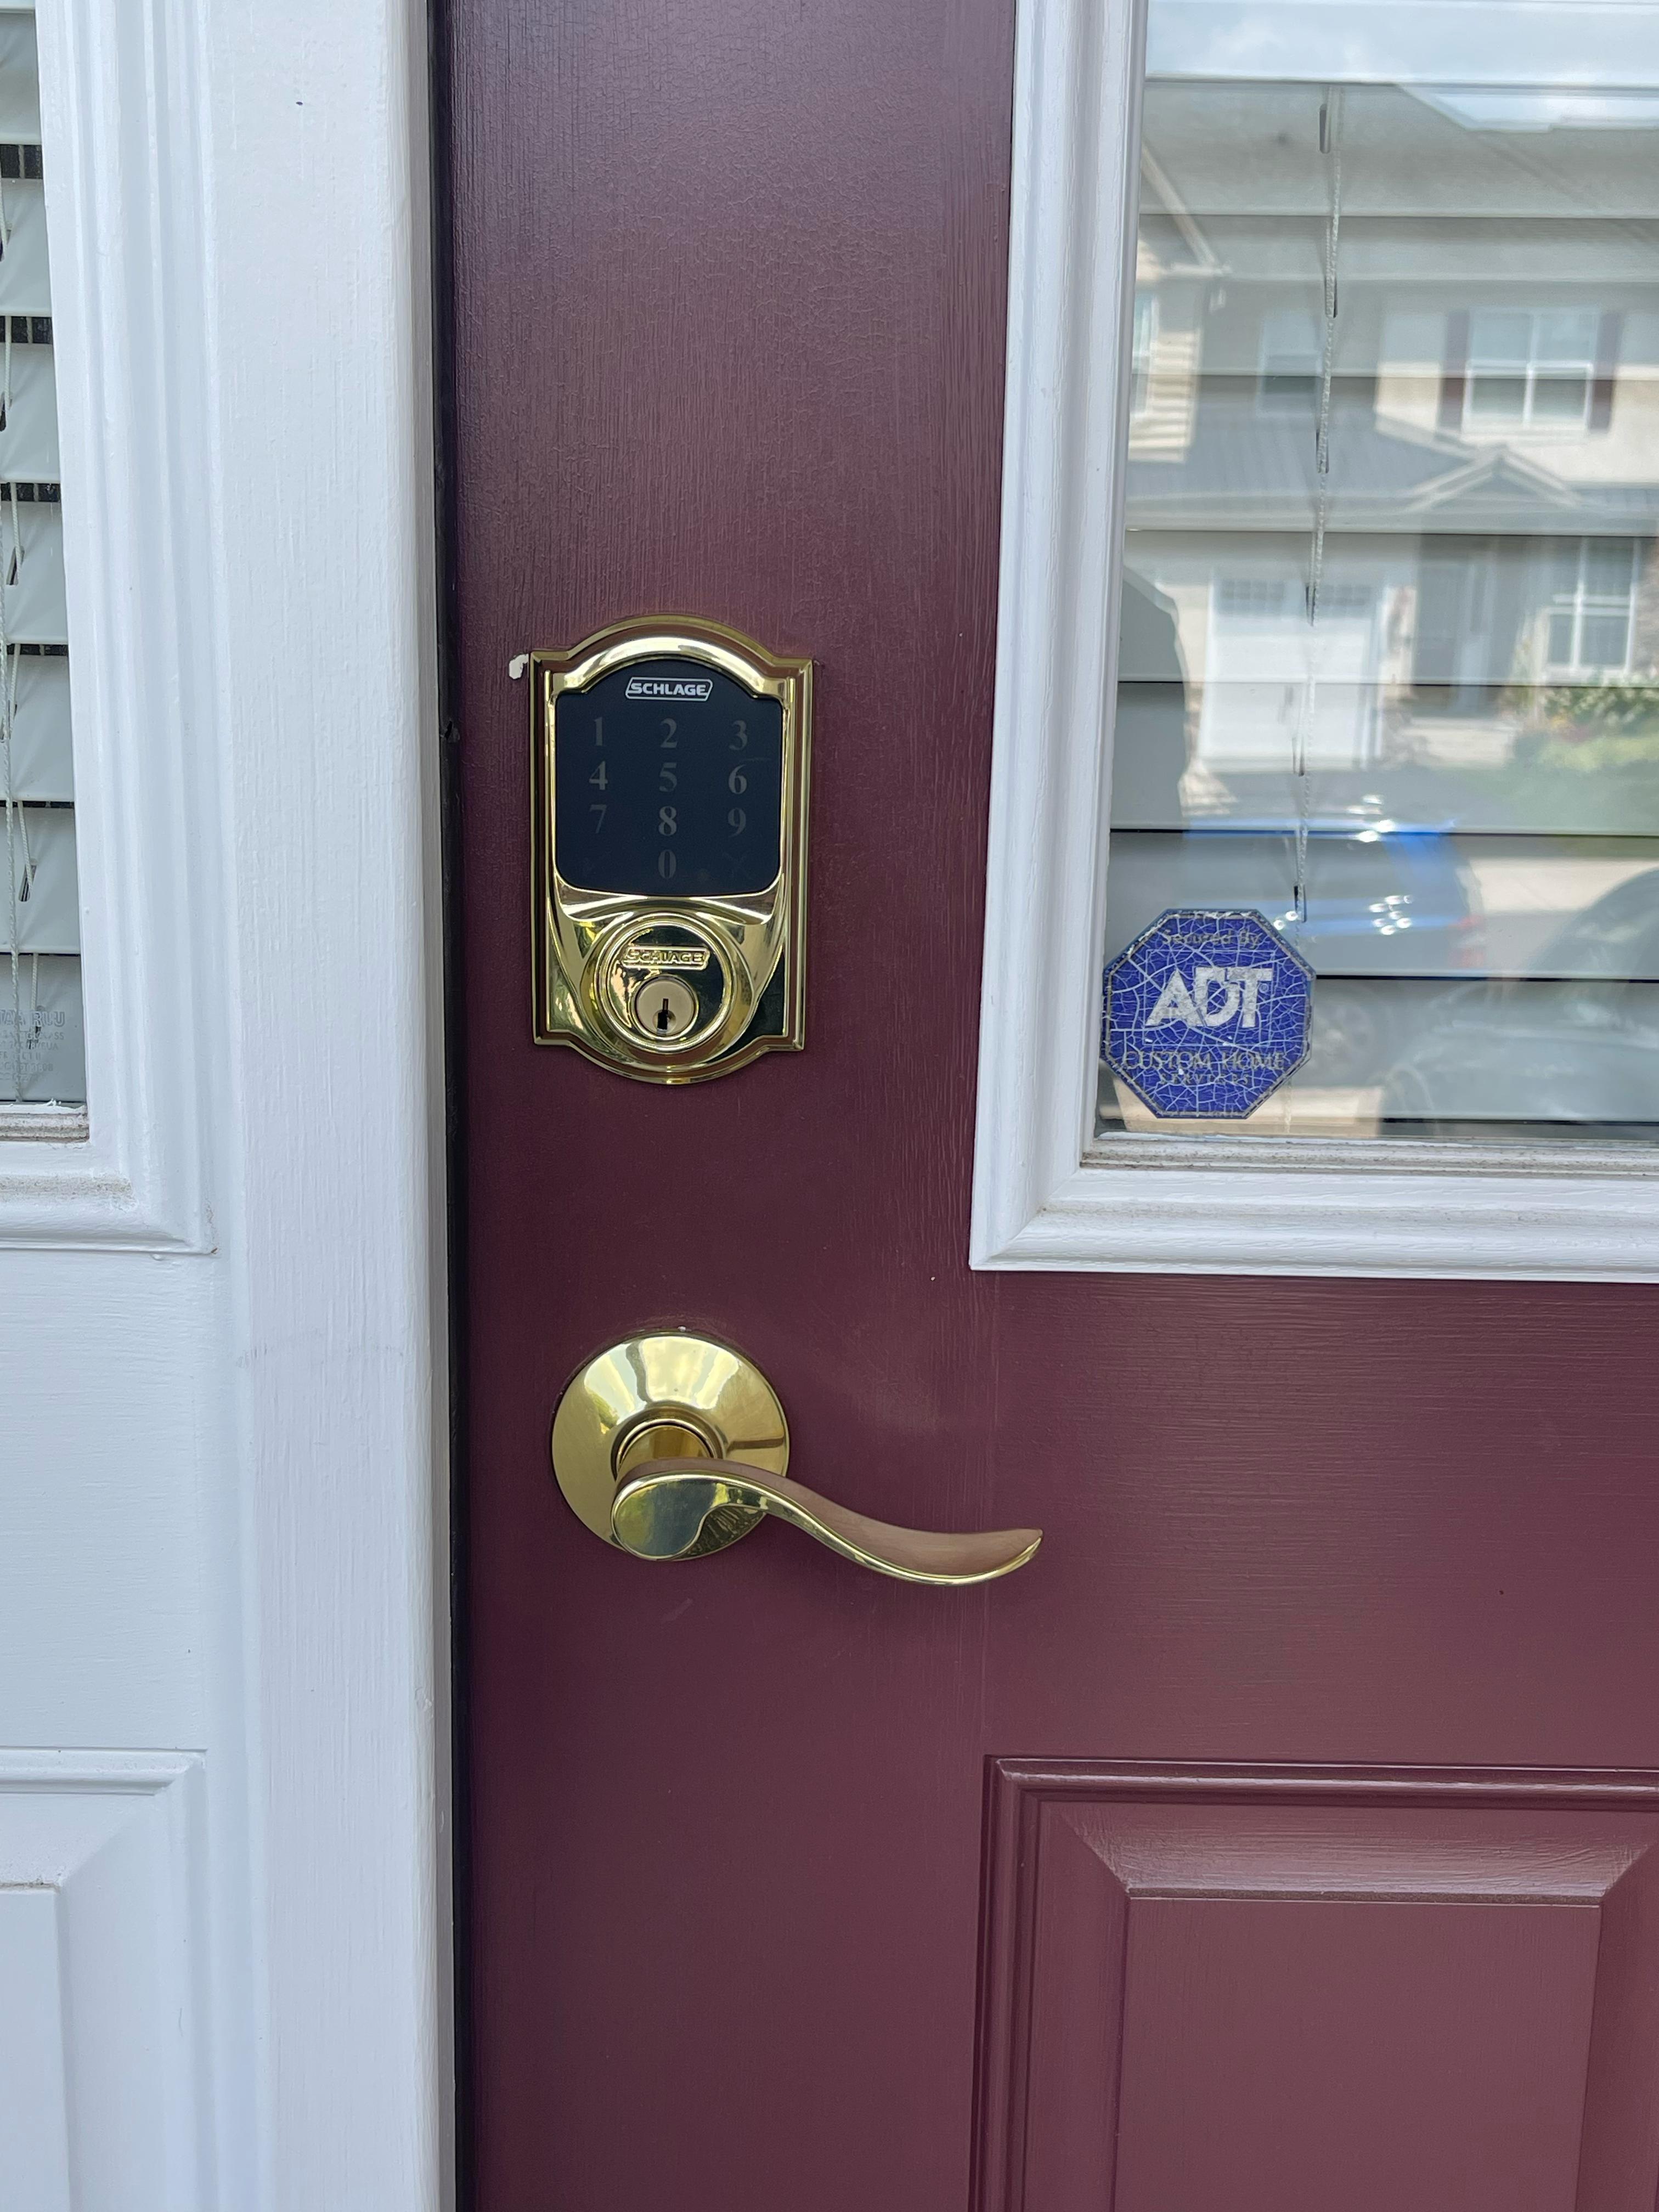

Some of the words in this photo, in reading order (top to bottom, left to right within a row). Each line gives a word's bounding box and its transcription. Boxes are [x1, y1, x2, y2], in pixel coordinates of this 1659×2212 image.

[629, 682, 707, 696] SCHLAGE
[592, 716, 606, 747] 1
[659, 718, 679, 749] 2
[728, 719, 748, 751] 3
[588, 760, 609, 791] 4
[658, 761, 678, 793] 5
[727, 764, 748, 795] 6
[588, 804, 608, 834] 7
[658, 805, 678, 837] 8
[727, 807, 747, 838] 9
[657, 849, 678, 880] 0
[625, 950, 704, 964] SCHLAGE
[1145, 967, 1272, 1028] ADT
[1125, 1051, 1211, 1070] CUSTOM
[1222, 1051, 1285, 1072] HOME
